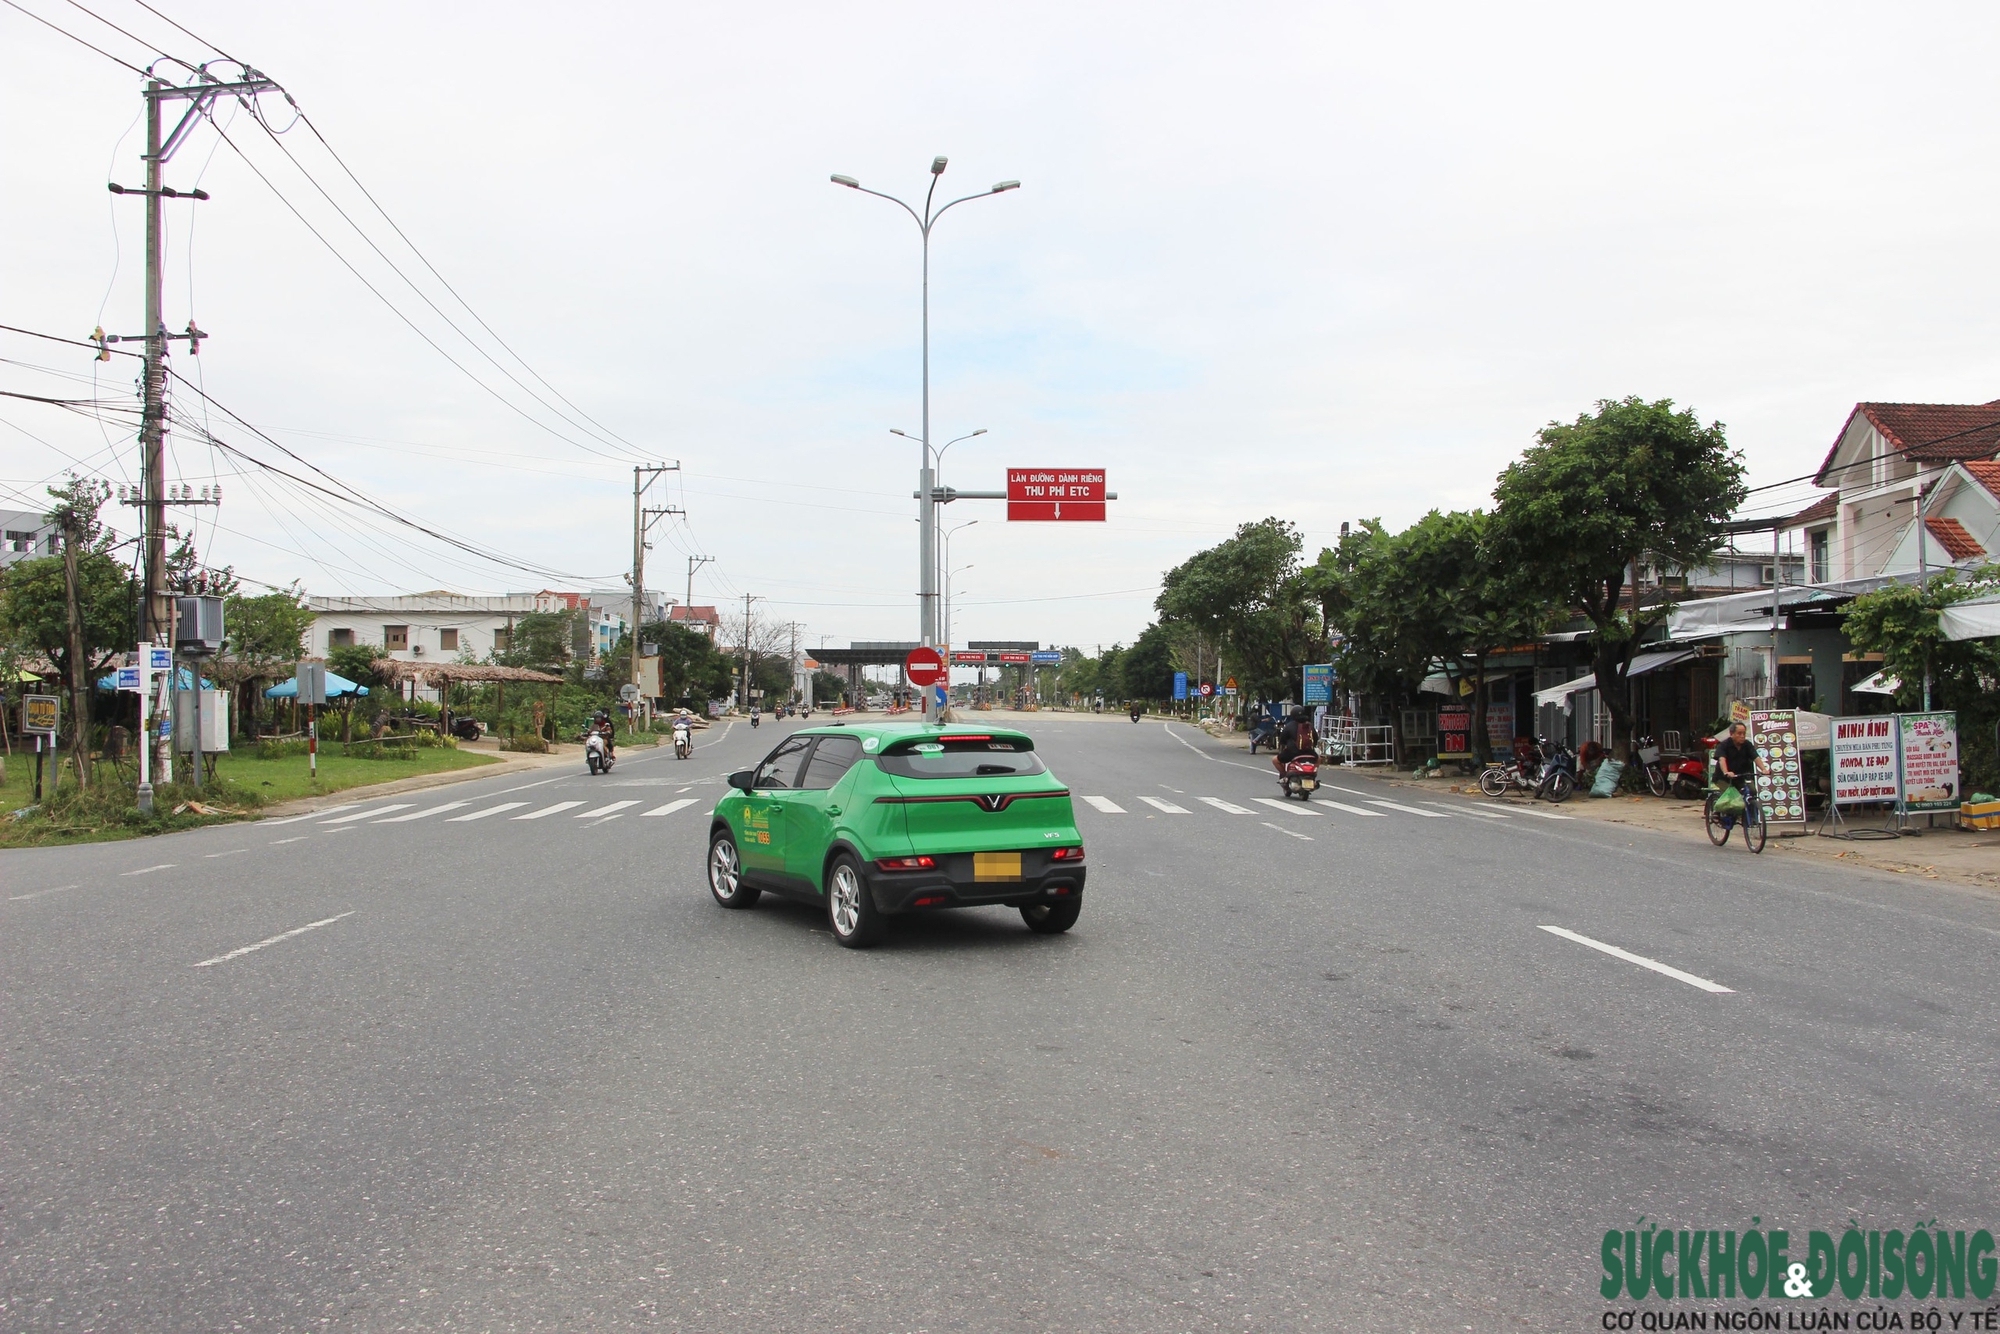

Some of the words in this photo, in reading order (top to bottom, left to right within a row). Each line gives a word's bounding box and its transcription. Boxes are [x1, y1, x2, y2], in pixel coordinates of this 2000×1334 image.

[1010, 472, 1026, 482] LÀN
[1030, 472, 1055, 482] ĐƯỜNG
[1058, 472, 1078, 482] DÀNH
[1080, 472, 1102, 482] RIÊNG
[1024, 486, 1044, 496] THU
[1049, 484, 1065, 496] PHÍ
[1070, 486, 1090, 496] ETC
[1438, 713, 1470, 731] PHOTOCOPY
[1770, 712, 1793, 720] Coffee
[1757, 720, 1790, 730] Menu
[1838, 723, 1864, 739] MINH
[1867, 719, 1889, 737] ÁNH
[1840, 757, 1864, 768] HONDA,
[1866, 756, 1875, 767] XE
[1876, 756, 1889, 768] ĐẠP
[1881, 786, 1896, 796] HONDA
[757, 831, 770, 845] 1055
